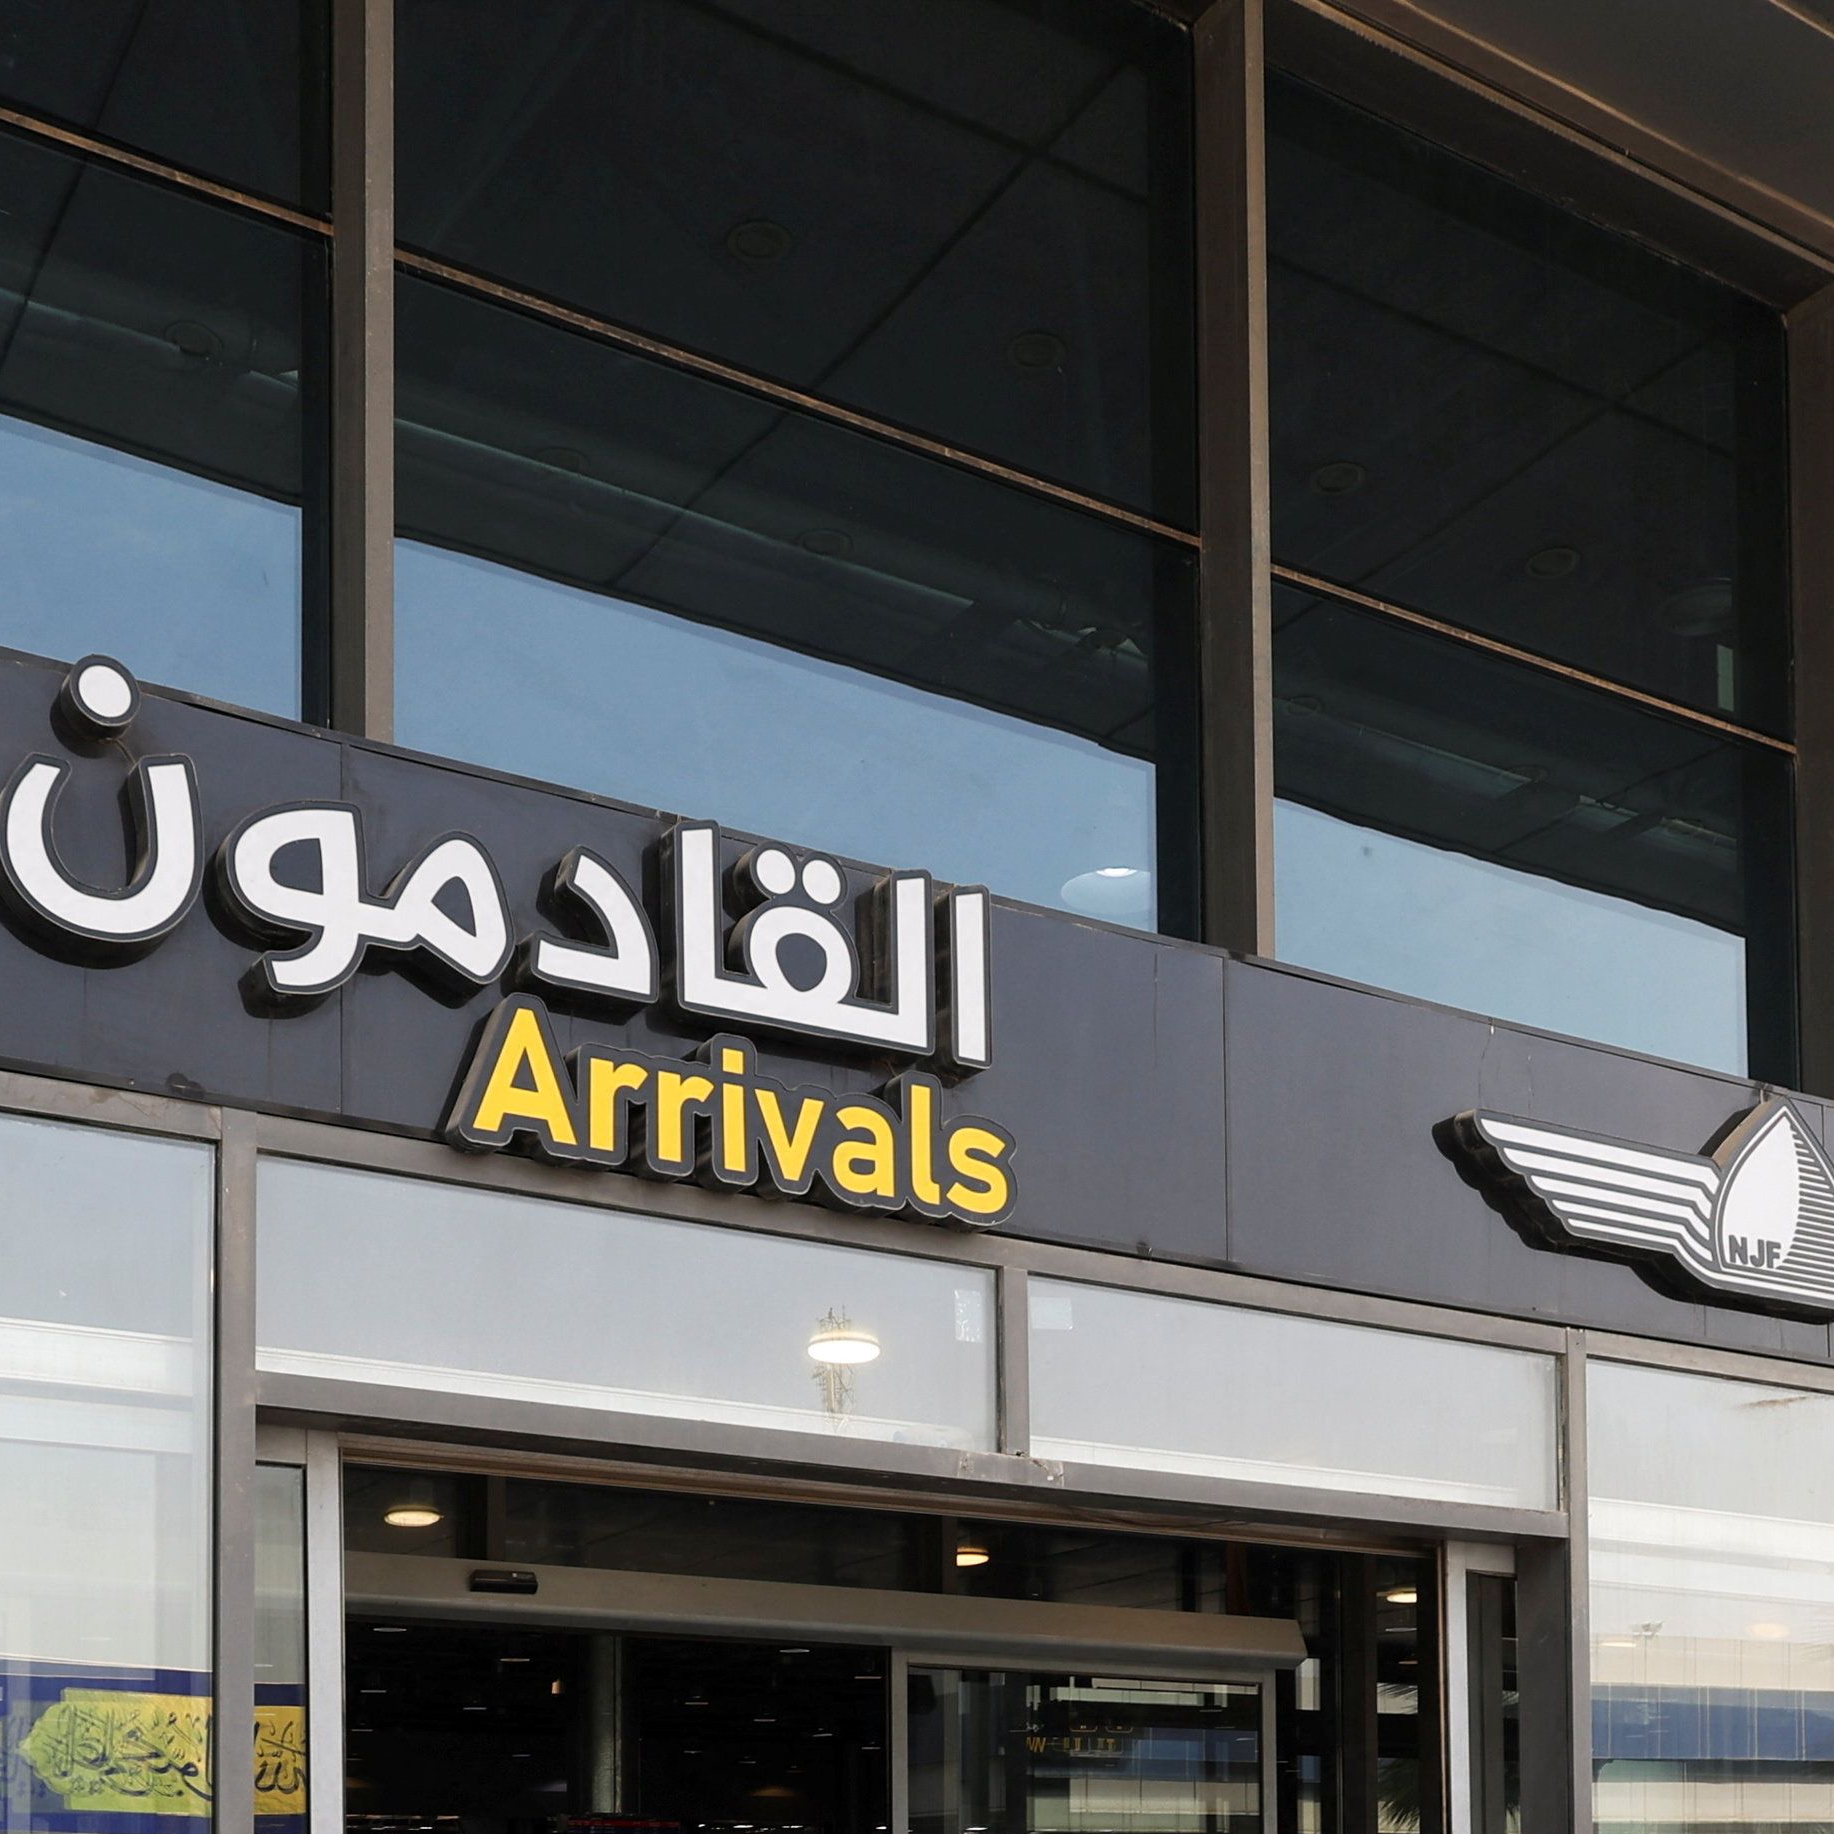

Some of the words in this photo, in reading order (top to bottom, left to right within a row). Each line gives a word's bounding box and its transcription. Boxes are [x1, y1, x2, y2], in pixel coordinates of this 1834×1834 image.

[5, 662, 991, 1066] القادمون
[474, 1005, 1011, 1214] Arrivals
[1728, 1234, 1781, 1269] NJF
